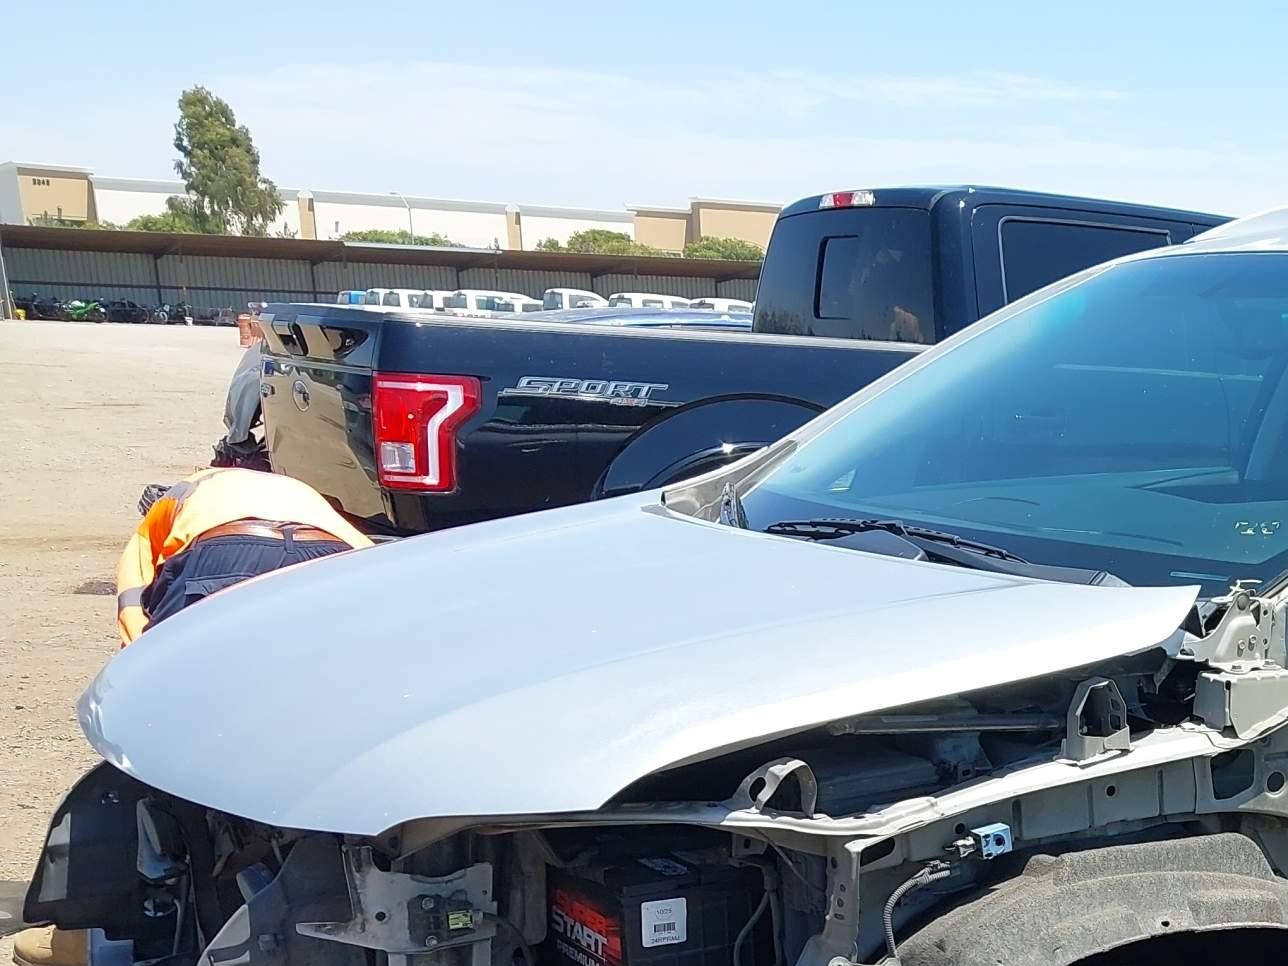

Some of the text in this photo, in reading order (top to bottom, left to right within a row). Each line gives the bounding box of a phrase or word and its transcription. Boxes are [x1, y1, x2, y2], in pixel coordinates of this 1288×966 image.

[514, 376, 669, 399] SPORT
[551, 904, 608, 956] START
[552, 889, 608, 938] SUPER
